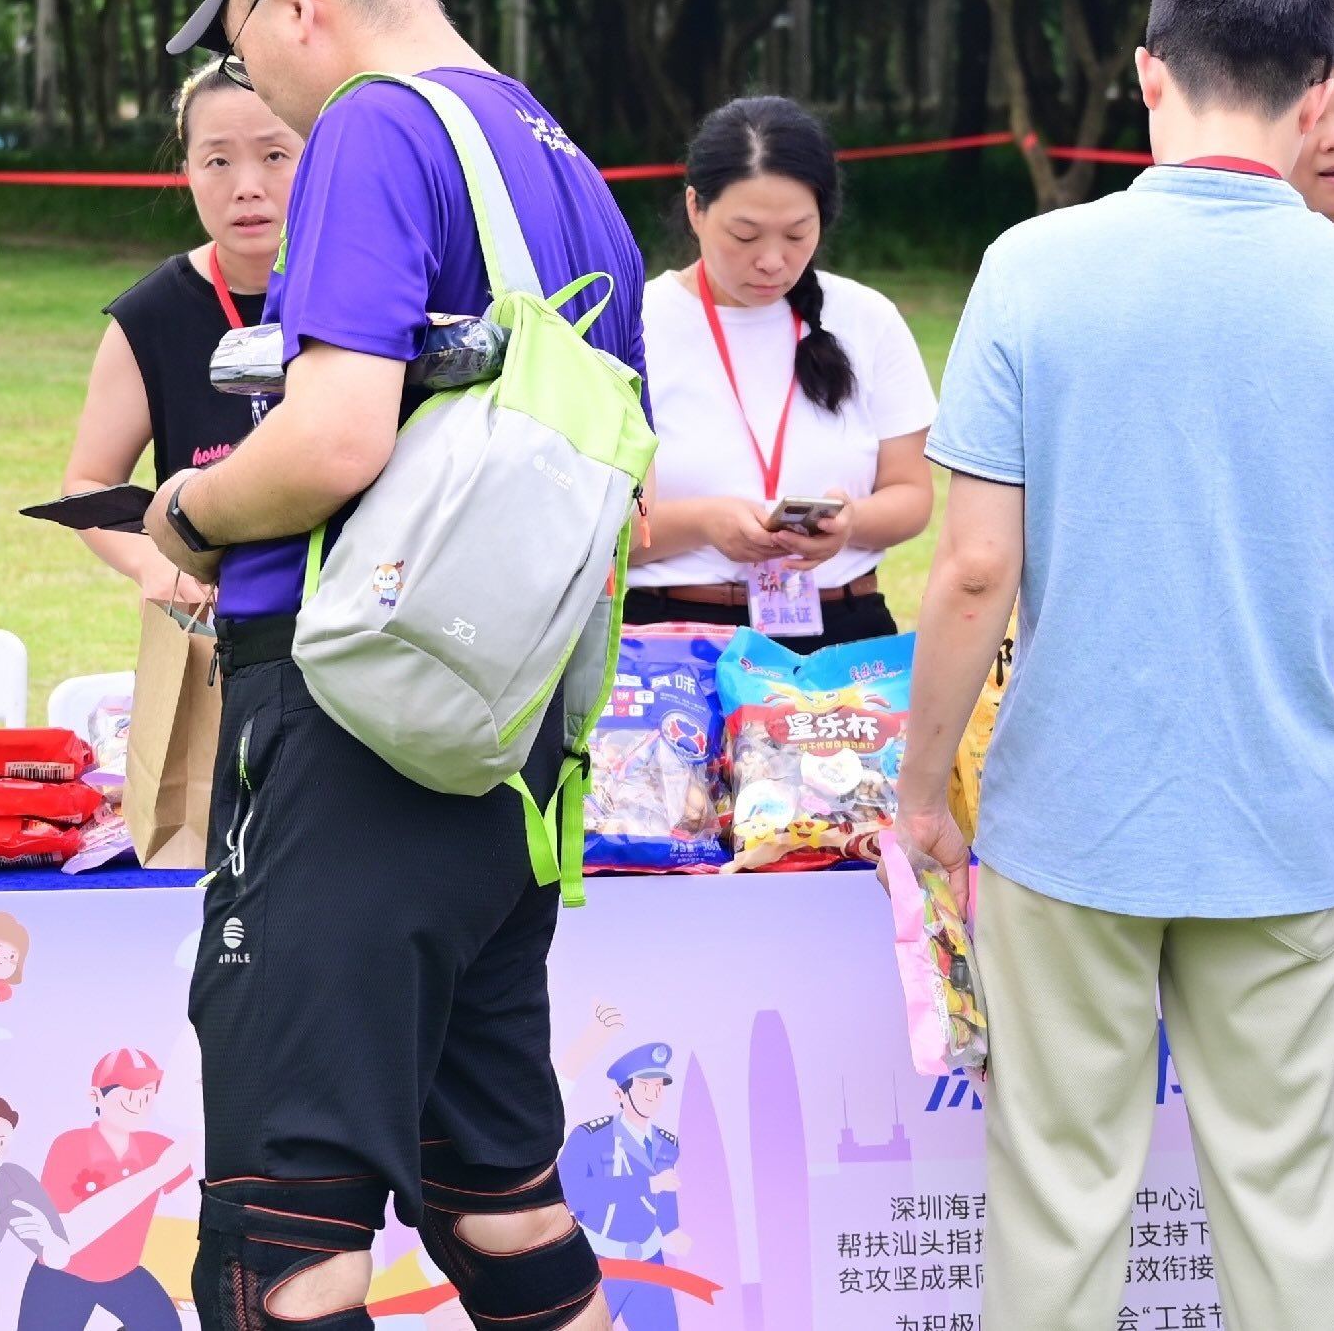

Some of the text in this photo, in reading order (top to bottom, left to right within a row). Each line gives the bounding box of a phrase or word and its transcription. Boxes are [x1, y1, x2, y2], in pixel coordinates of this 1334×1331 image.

[784, 712, 880, 742] 星乐杯
[1129, 1220, 1210, 1248] 支持下
